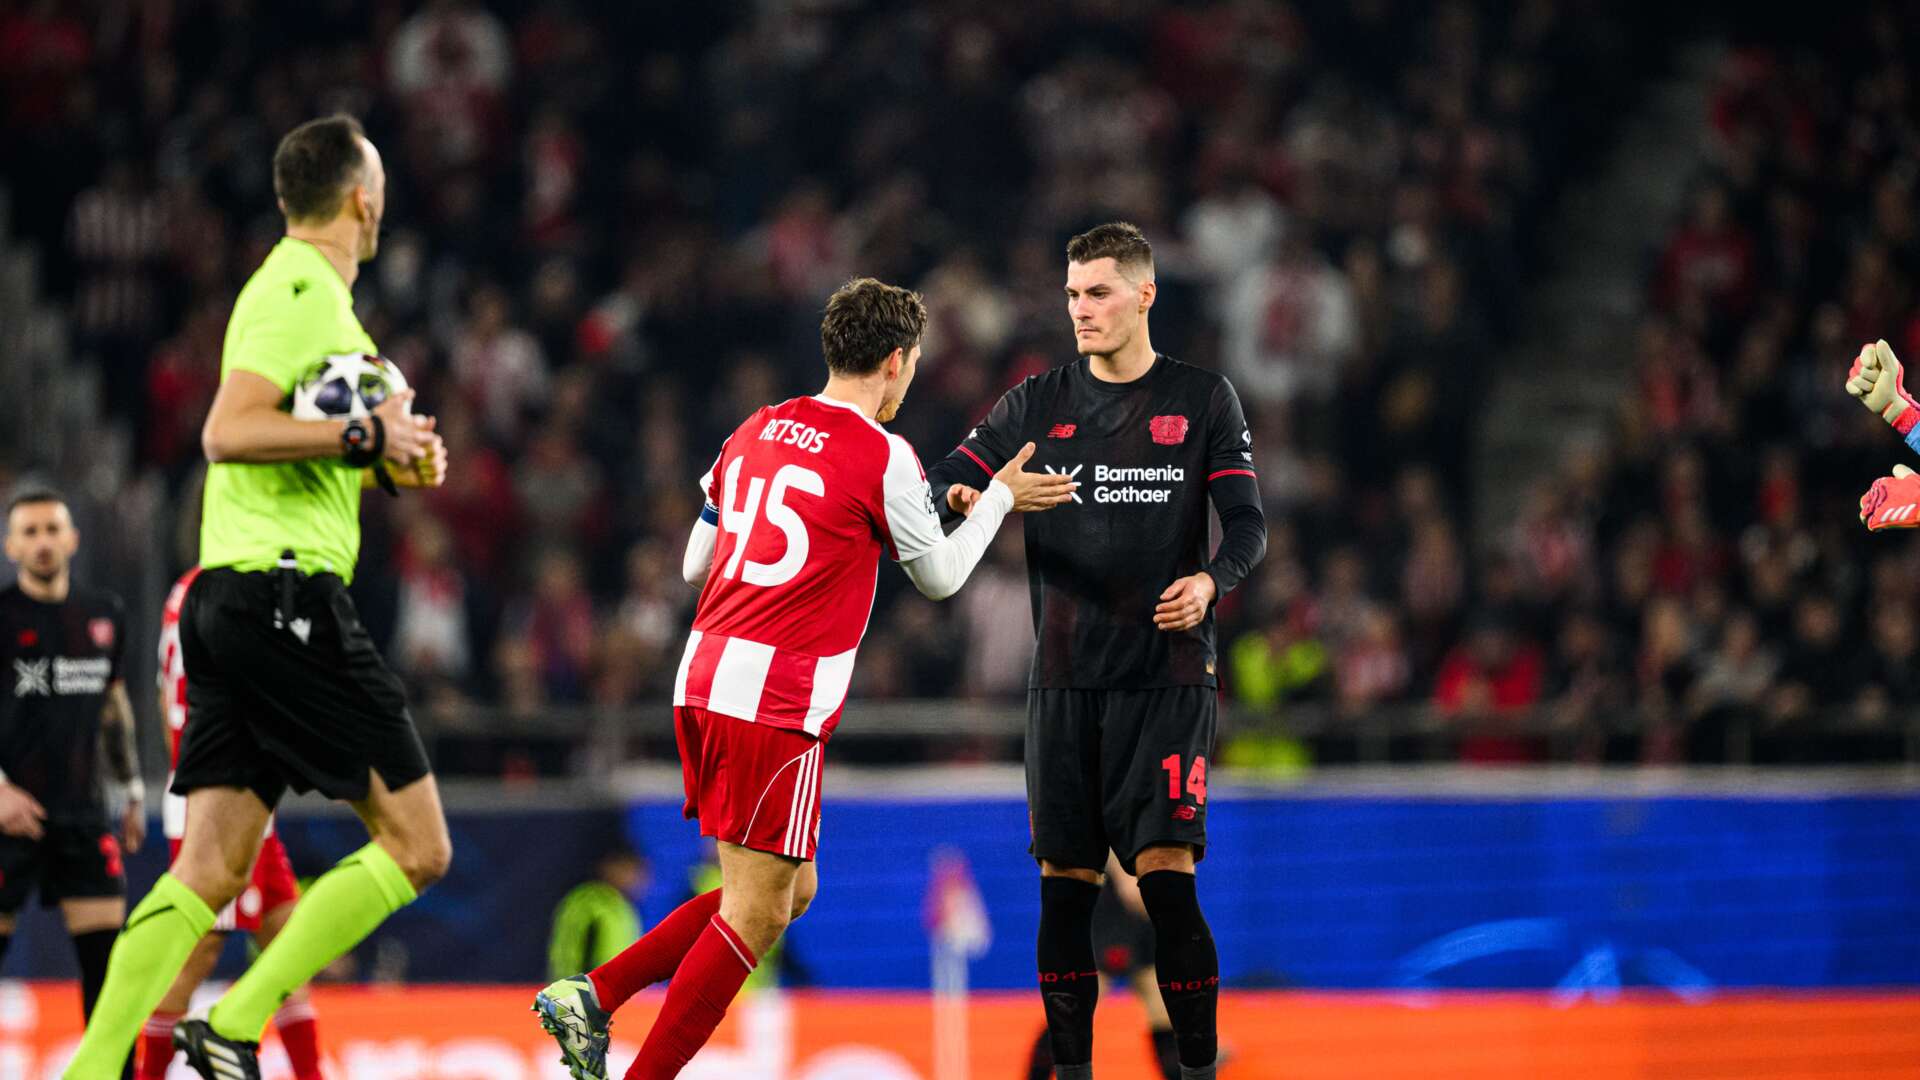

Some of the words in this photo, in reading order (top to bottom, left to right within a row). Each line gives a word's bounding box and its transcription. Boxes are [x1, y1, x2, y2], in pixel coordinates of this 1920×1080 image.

[758, 418, 831, 454] RETSOS
[1094, 464, 1185, 482] Barmenia
[1093, 485, 1172, 504] Gothaer
[721, 454, 825, 588] 45
[1162, 753, 1207, 805] 14
